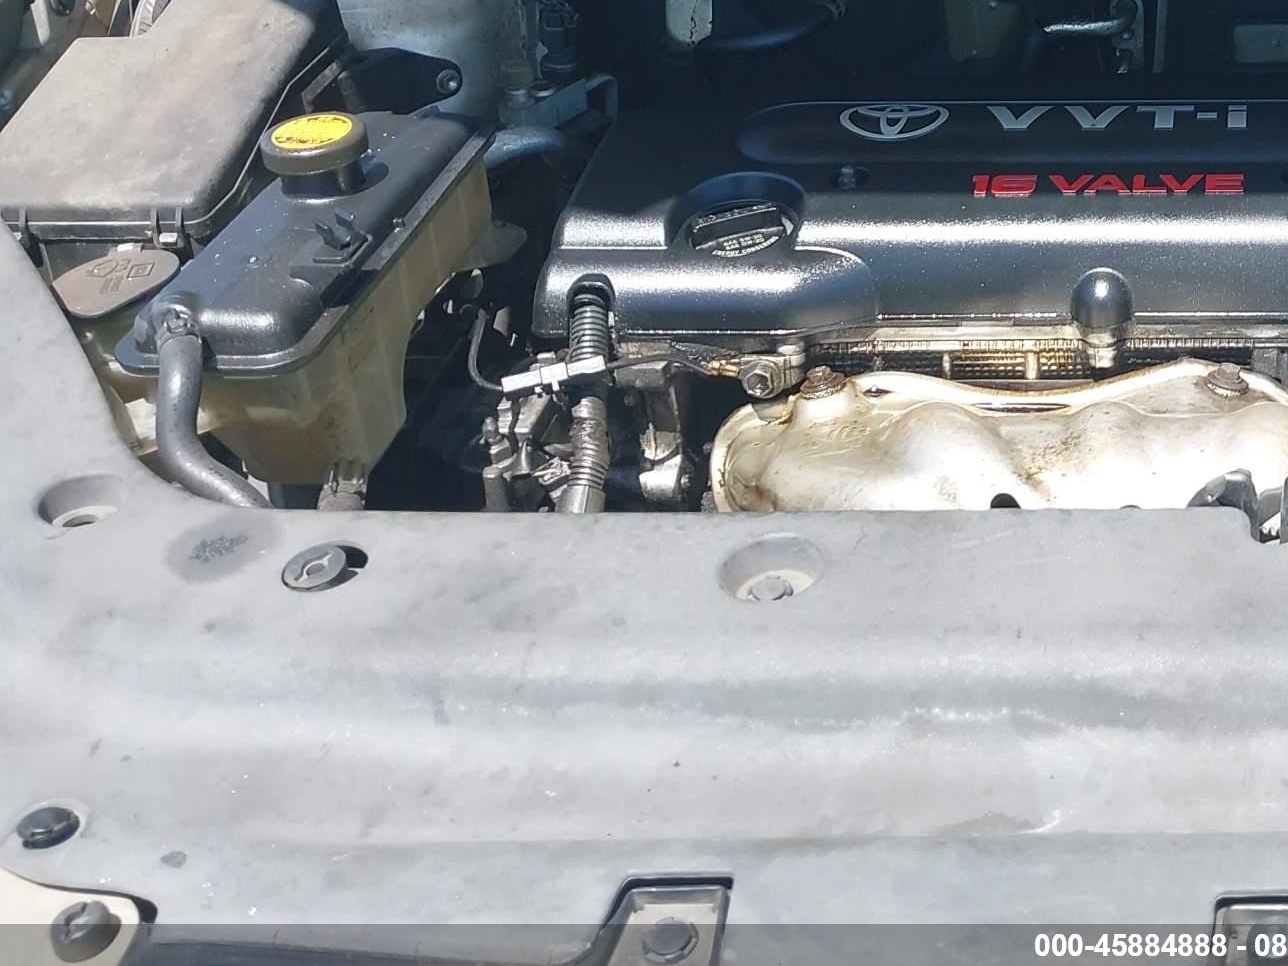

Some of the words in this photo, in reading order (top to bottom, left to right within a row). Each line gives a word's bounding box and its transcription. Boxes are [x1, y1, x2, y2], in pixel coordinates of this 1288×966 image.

[986, 105, 1248, 130] VVT-i
[972, 174, 1038, 197] 16
[1048, 174, 1245, 195] VALVE
